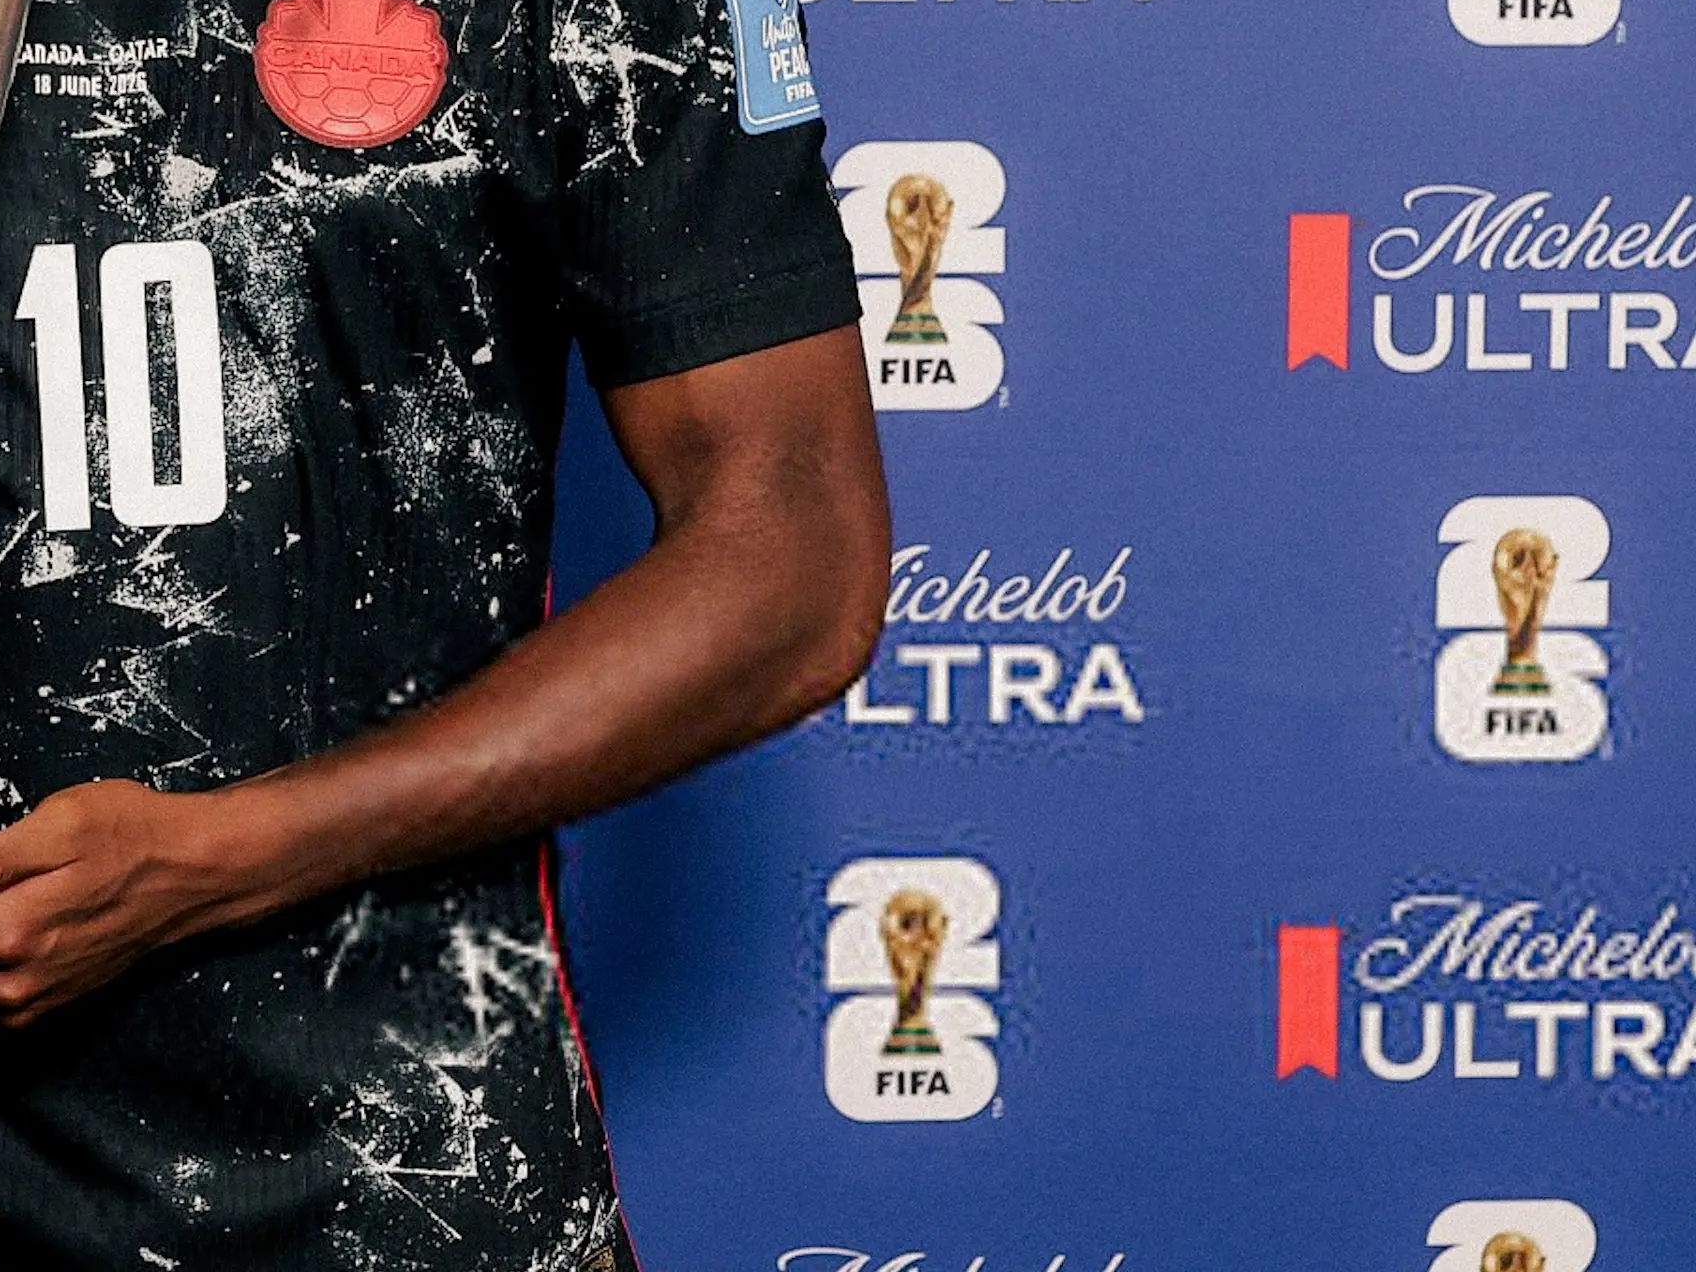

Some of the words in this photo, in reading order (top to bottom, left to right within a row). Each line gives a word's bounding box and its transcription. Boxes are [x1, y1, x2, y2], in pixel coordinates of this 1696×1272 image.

[16, 42, 87, 66] ANADA
[108, 38, 169, 63] QATAR
[266, 45, 437, 79] CANADA
[33, 73, 52, 95] 18
[57, 74, 103, 98] JUNE
[109, 72, 148, 96] 2026
[784, 80, 815, 103] FIFA
[1368, 184, 1696, 280] Michelo
[1373, 292, 1696, 373] ULTR
[16, 239, 227, 531] 10
[881, 359, 955, 384] FIFA
[844, 644, 1144, 723] LTRA
[1486, 710, 1557, 734] FIFA
[1357, 896, 1696, 992] Michelo
[877, 1071, 950, 1096] FIFA
